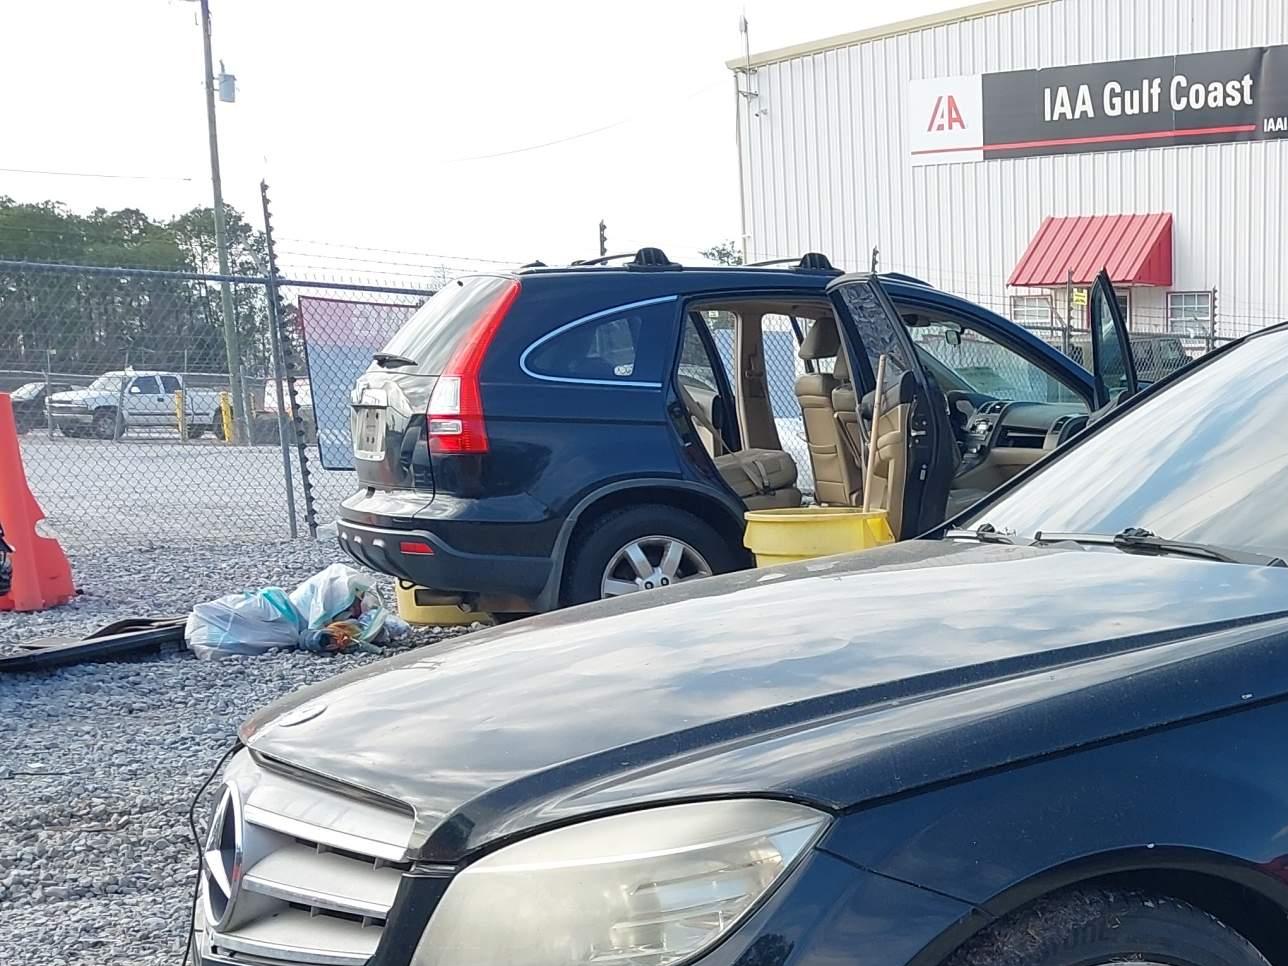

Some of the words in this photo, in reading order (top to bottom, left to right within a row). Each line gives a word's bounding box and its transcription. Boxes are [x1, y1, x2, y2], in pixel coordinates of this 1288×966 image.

[1044, 84, 1095, 122] IAA
[1103, 77, 1161, 117] Gulf
[1170, 73, 1253, 112] Coast
